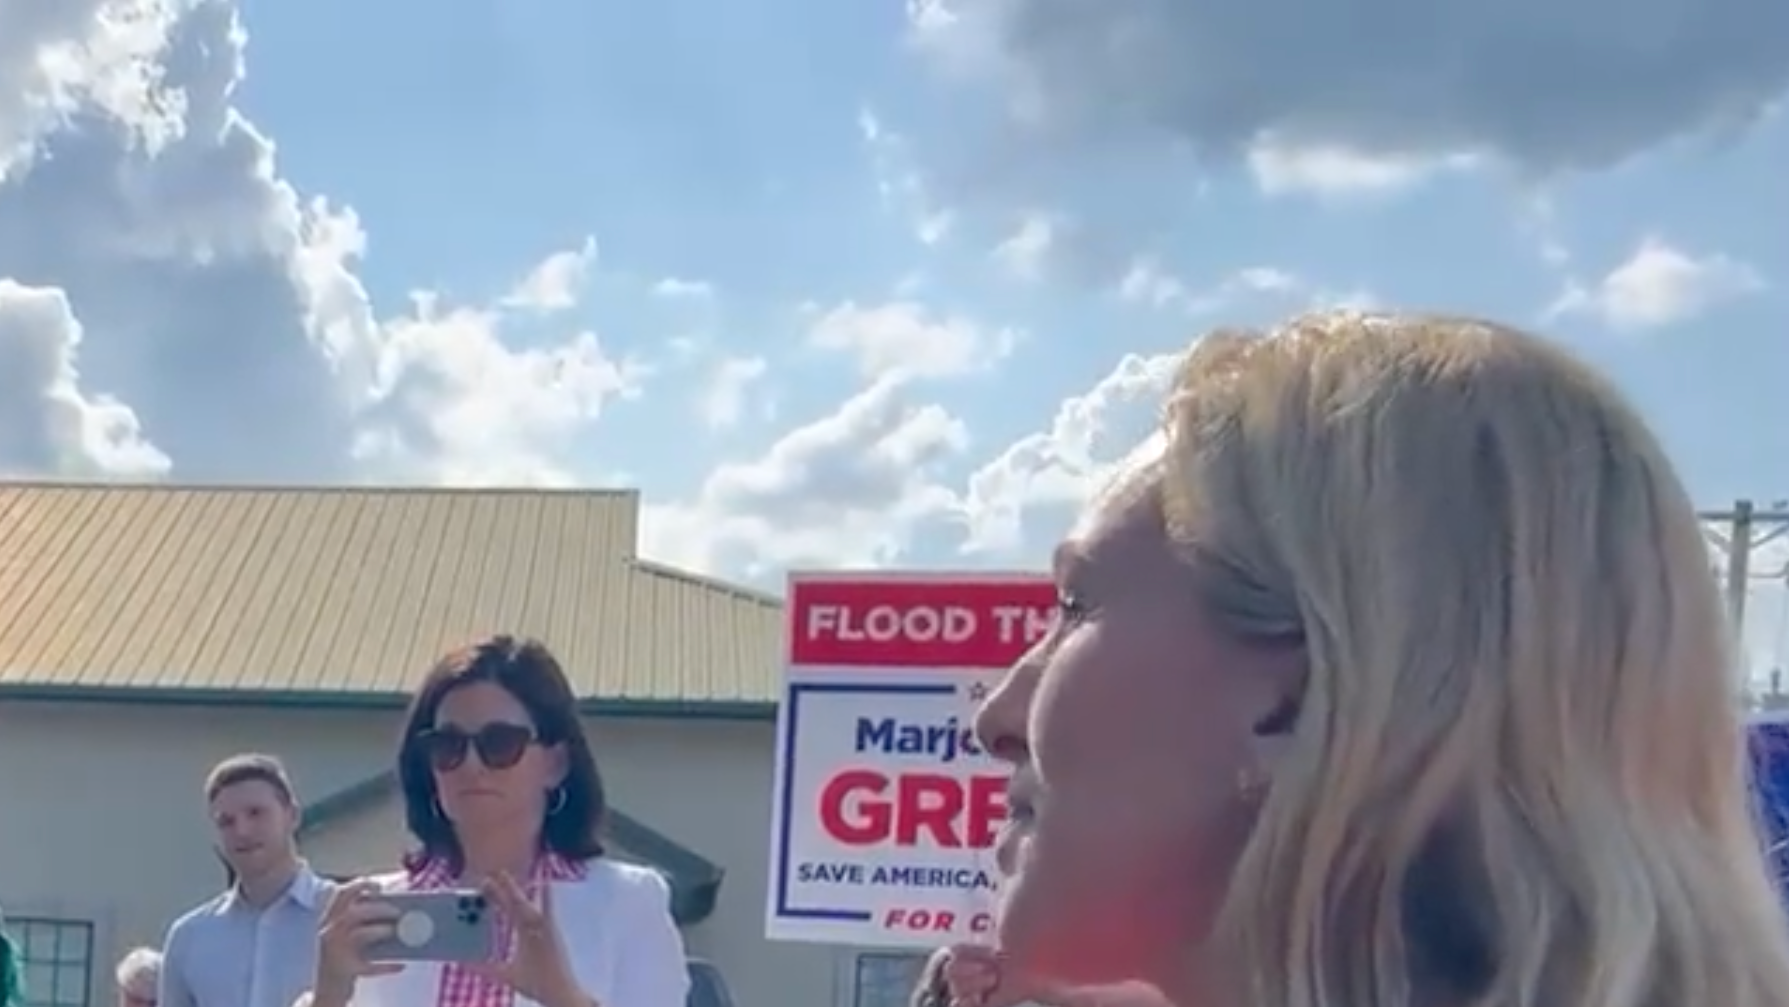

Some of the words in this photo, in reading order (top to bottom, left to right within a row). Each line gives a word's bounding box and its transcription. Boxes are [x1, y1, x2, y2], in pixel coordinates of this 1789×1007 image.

[807, 605, 976, 643] FLOOD
[798, 863, 864, 884] SAVE
[885, 909, 956, 932] FOR
